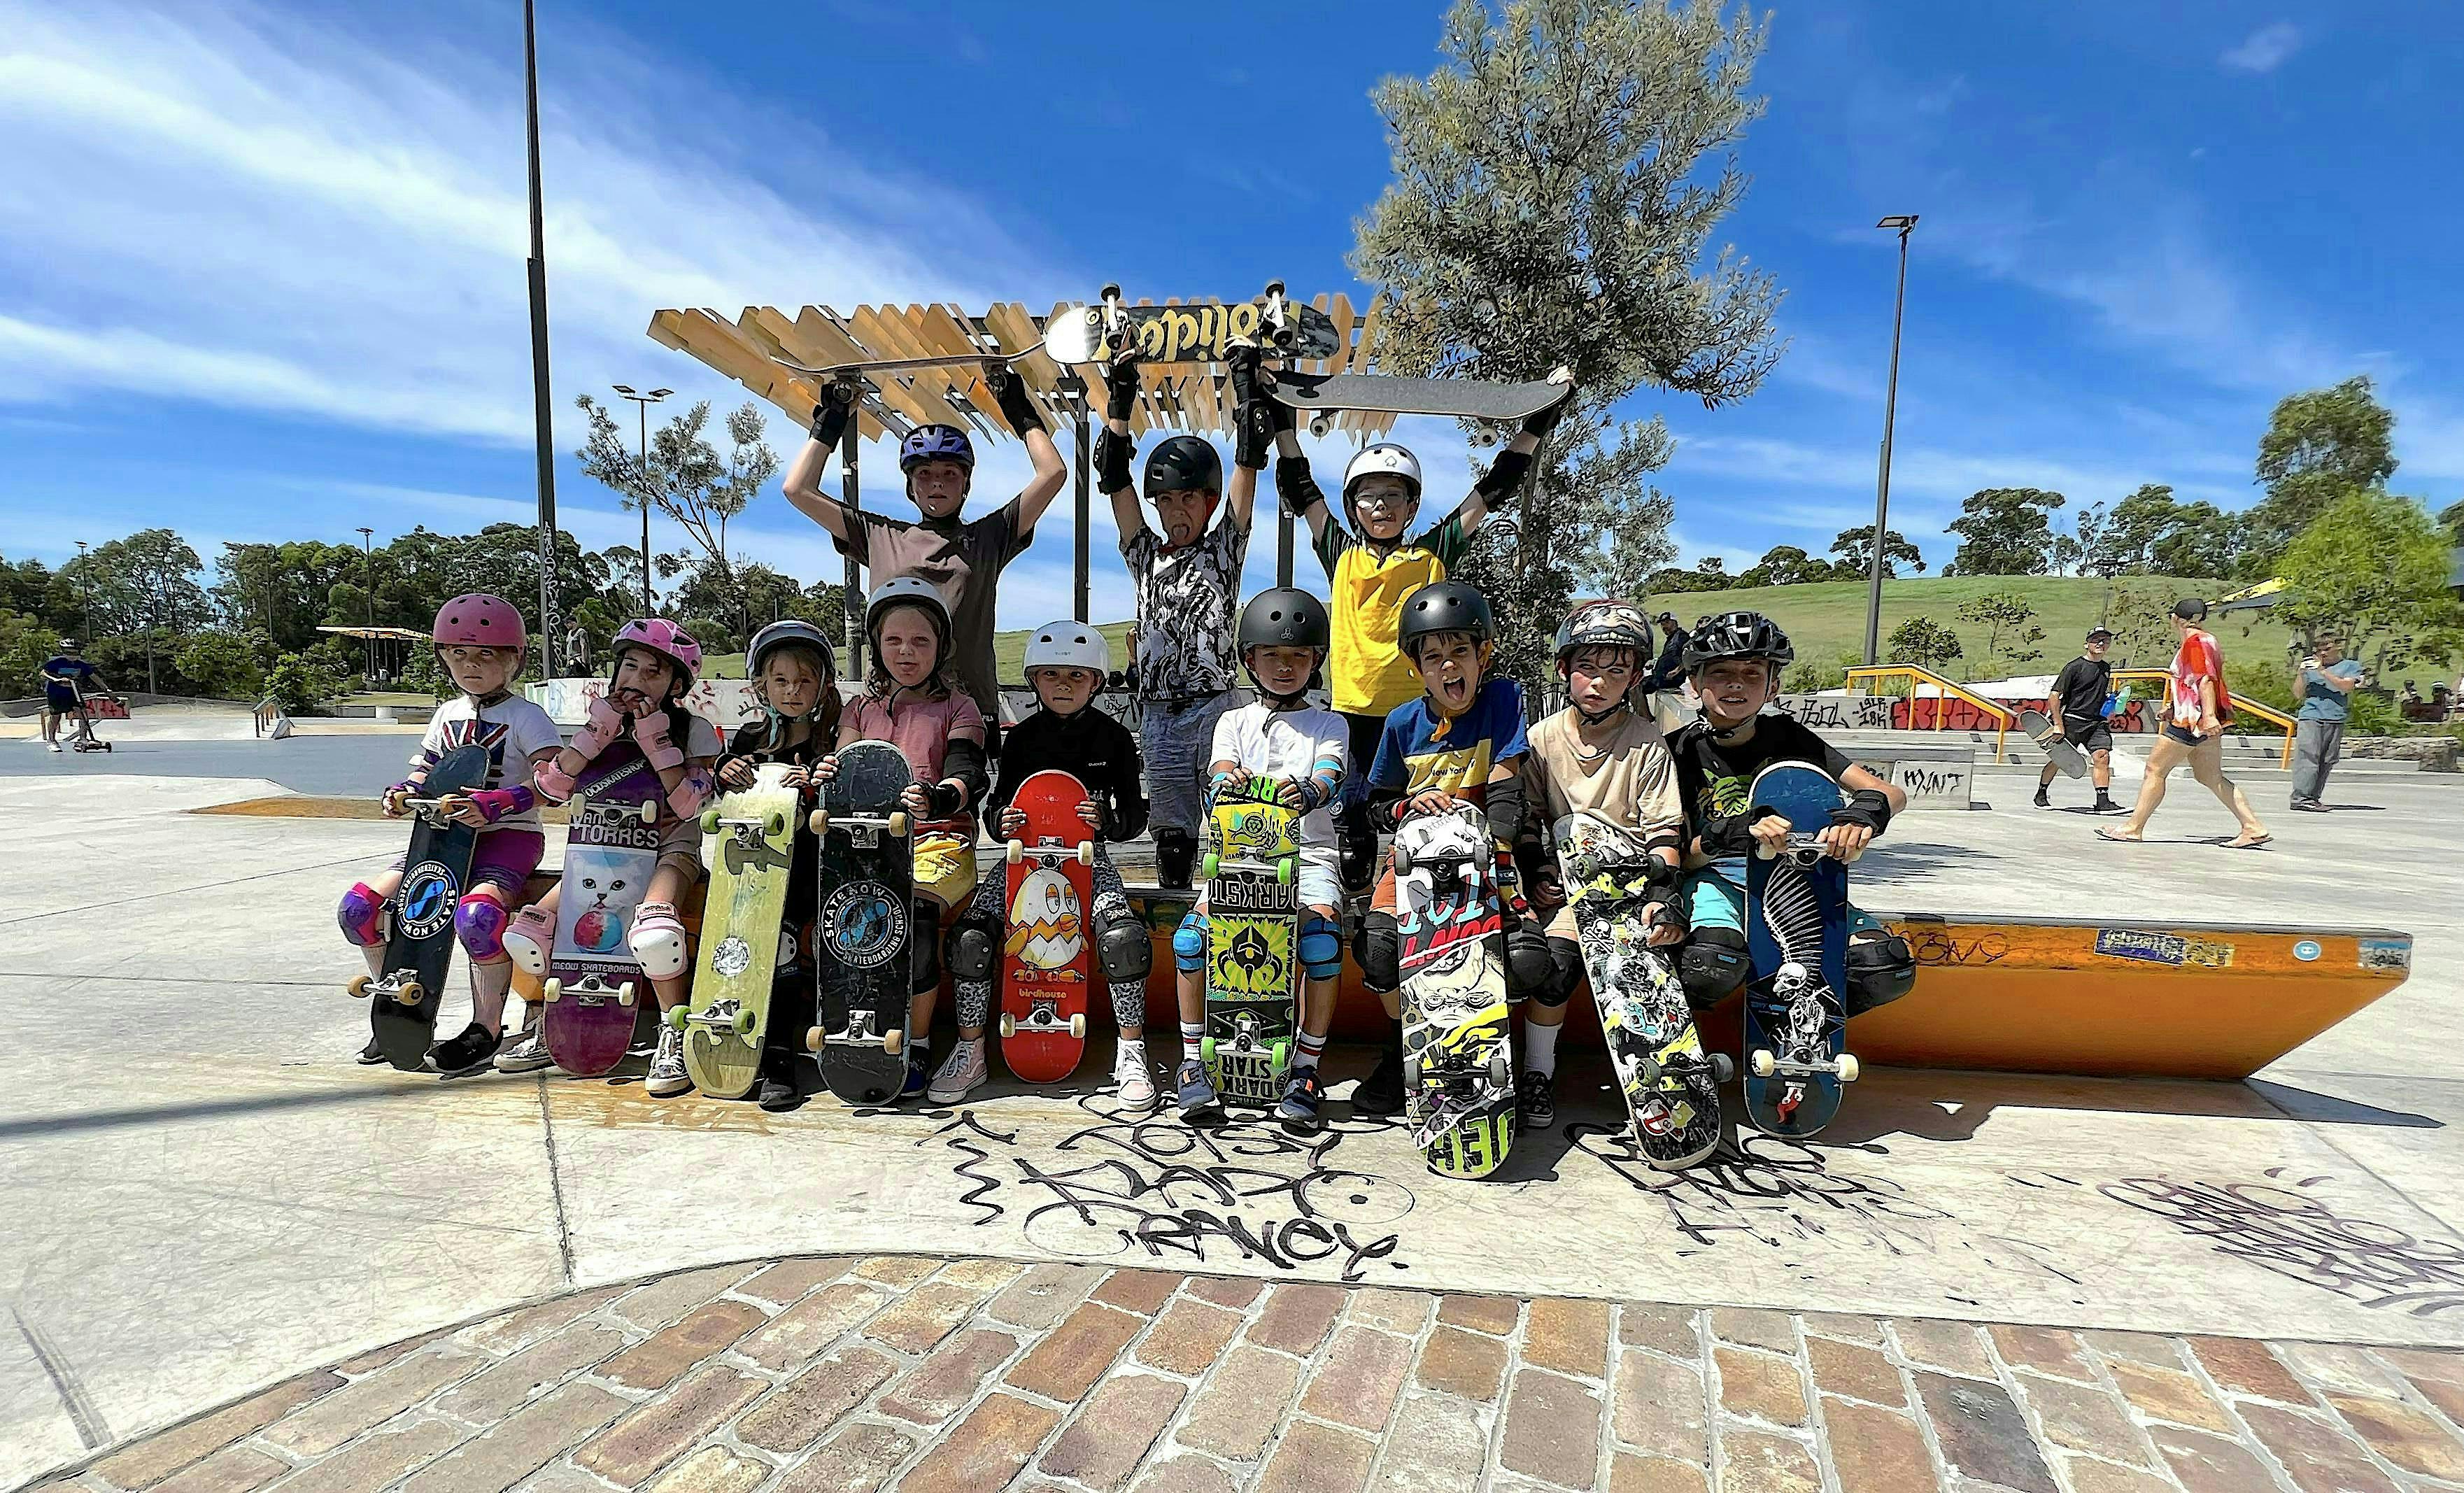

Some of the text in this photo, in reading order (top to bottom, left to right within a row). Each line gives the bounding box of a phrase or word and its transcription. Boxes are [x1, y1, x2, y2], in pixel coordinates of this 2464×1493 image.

[581, 823, 660, 849] TORRES
[404, 889, 456, 936] SKATE NOW
[825, 884, 885, 937] SKATE NOW
[843, 904, 904, 965] SKATEBOARDING SCHOOL
[551, 961, 641, 974] MEOW SKATEBOARDS
[1019, 988, 1067, 998] birdhouse
[1222, 1054, 1272, 1079] STAR
[1222, 1074, 1273, 1098] DARK
